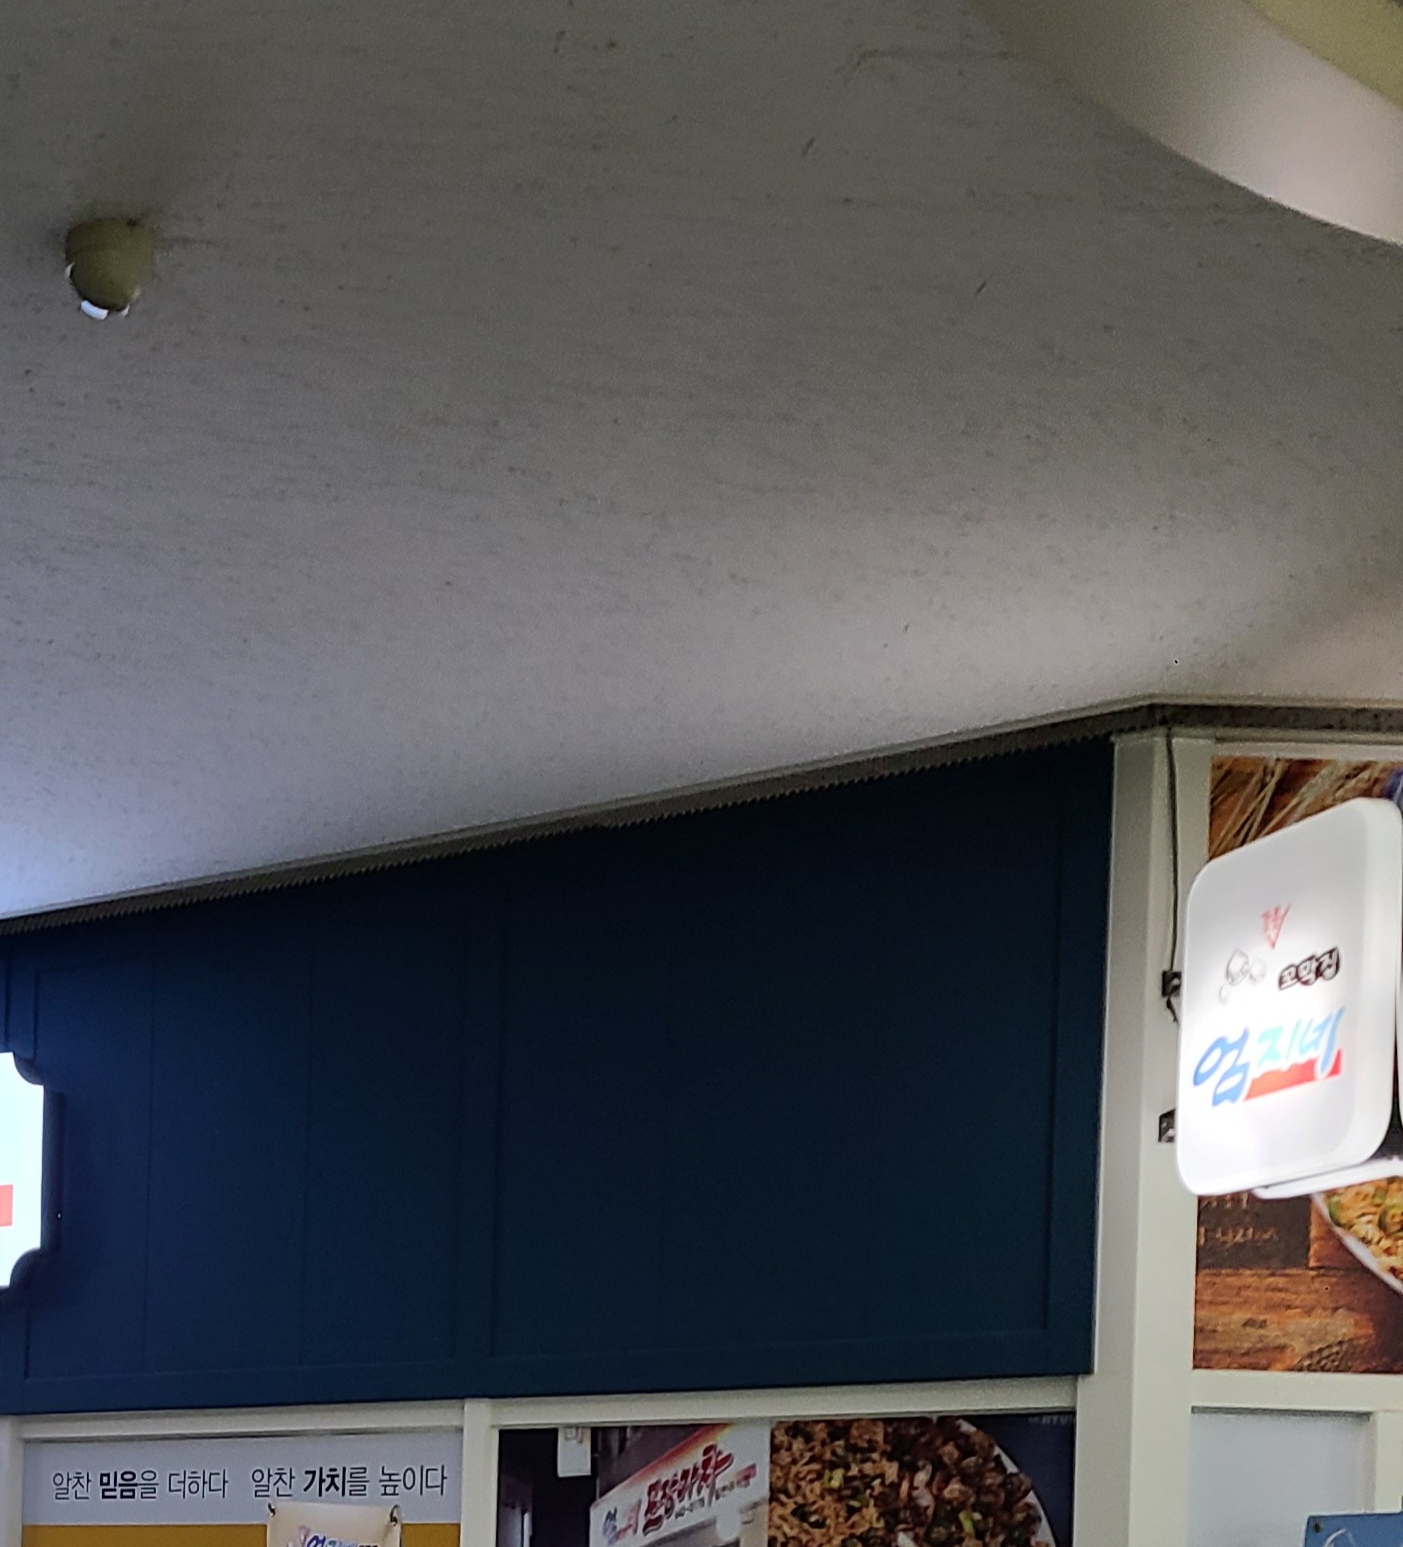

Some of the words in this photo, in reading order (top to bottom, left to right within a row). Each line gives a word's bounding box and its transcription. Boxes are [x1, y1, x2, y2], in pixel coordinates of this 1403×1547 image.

[1193, 1005, 1346, 1108] 엄지네
[52, 1471, 92, 1501] 알찬
[99, 1470, 160, 1501] 믿음을
[168, 1468, 229, 1500] 더하다
[251, 1466, 296, 1499] 알찬
[303, 1465, 371, 1498] 가치를
[378, 1463, 448, 1497] 높이다
